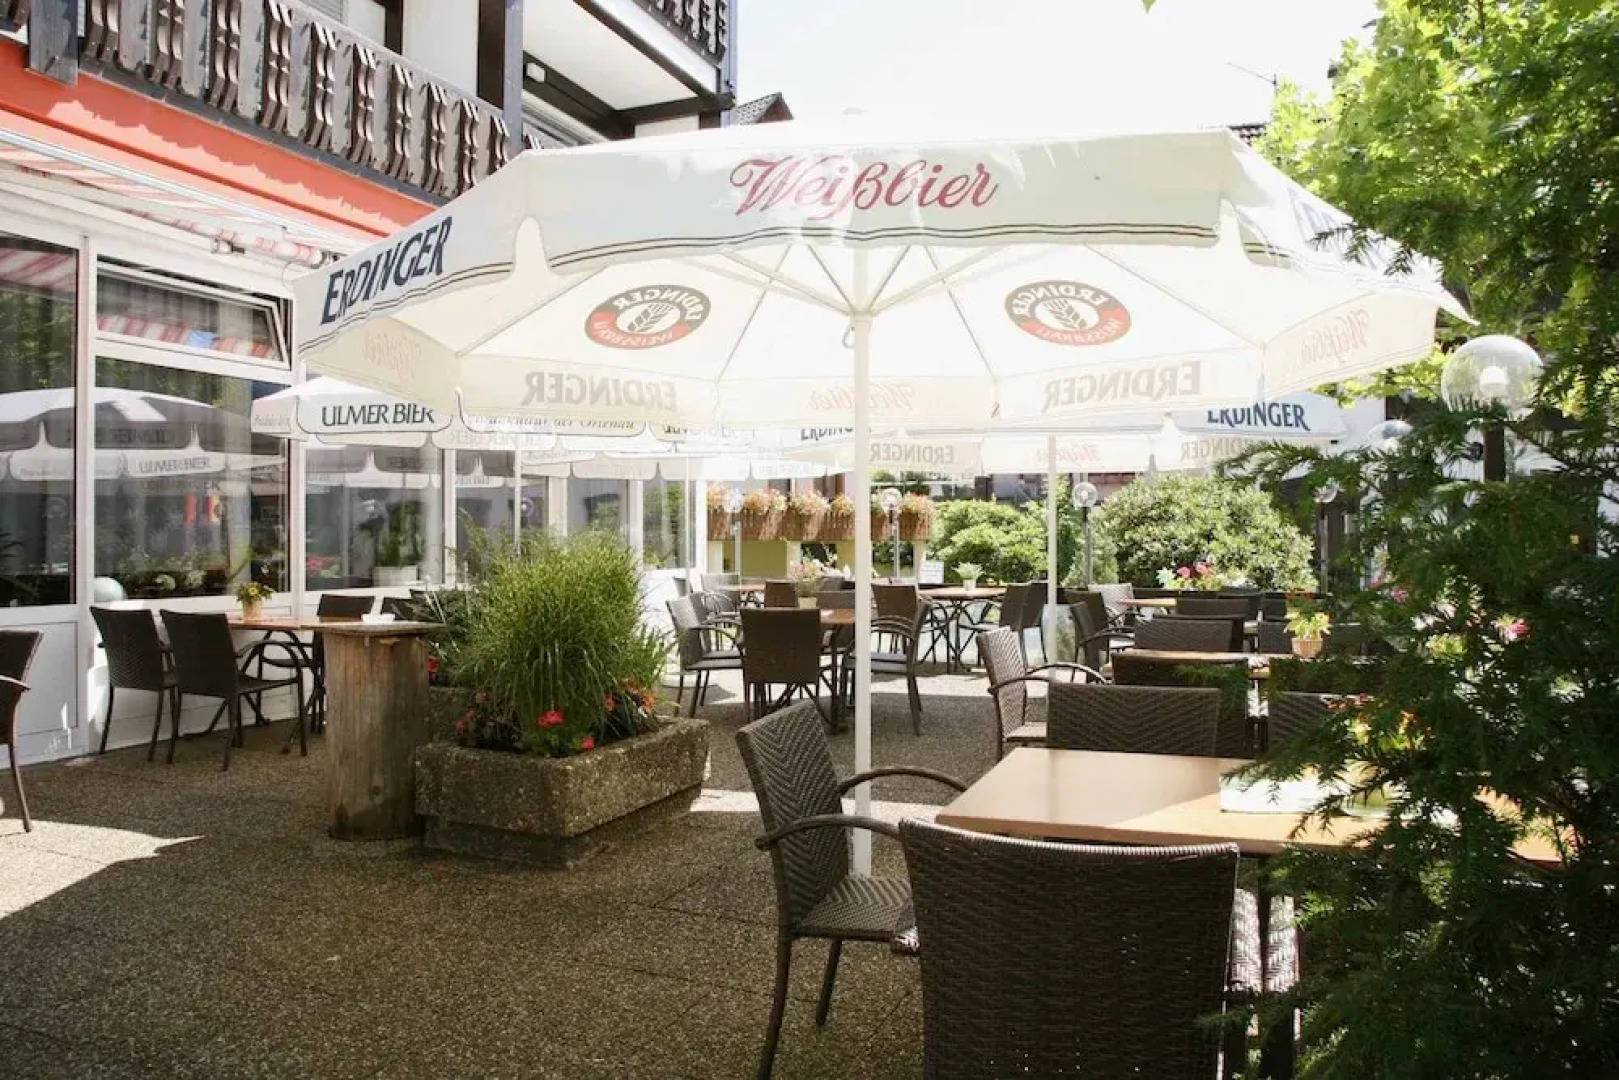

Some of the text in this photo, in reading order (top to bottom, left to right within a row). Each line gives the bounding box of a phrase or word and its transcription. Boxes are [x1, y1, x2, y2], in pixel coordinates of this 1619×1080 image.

[730, 155, 998, 220] Weißbier
[321, 216, 453, 325] ERDINGER
[322, 405, 389, 427] ULMER
